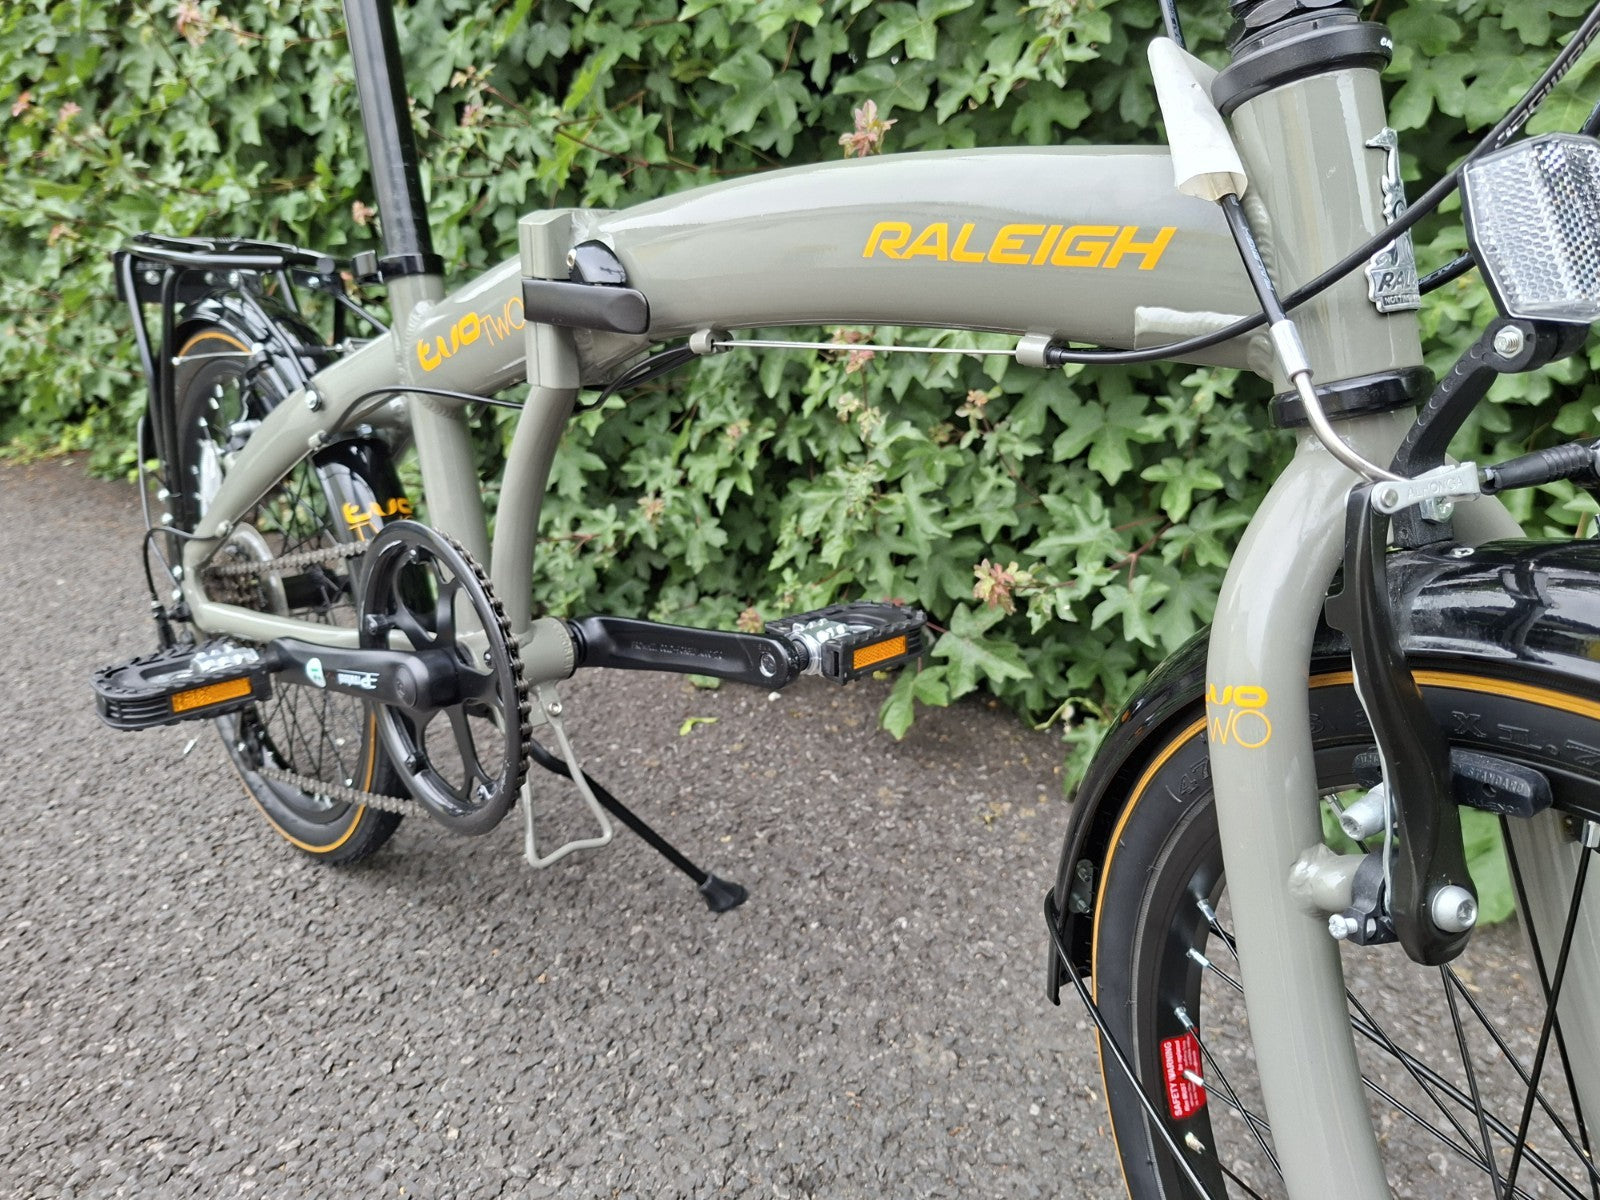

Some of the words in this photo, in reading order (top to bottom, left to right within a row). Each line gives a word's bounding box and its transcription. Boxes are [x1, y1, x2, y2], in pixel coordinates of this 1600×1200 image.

[862, 221, 1177, 270] RALEIGH
[480, 296, 526, 347] TWO
[1205, 704, 1273, 749] WO
[1164, 1041, 1176, 1082] WARNING
[1169, 1082, 1183, 1117] SAFETY
